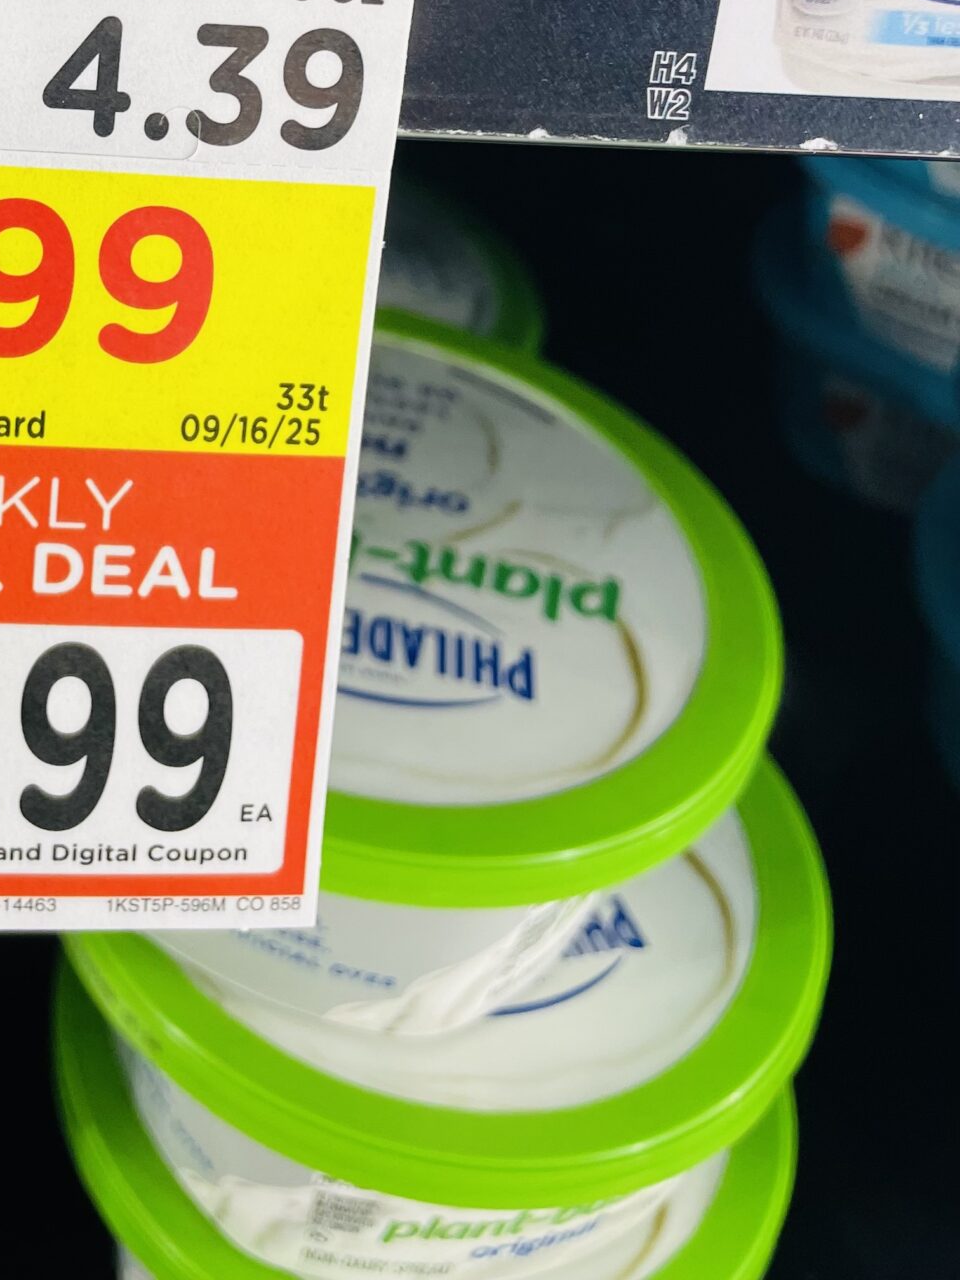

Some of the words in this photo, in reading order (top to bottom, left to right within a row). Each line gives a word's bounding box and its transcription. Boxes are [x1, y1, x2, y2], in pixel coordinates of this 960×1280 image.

[42, 15, 365, 151] 4.39
[649, 51, 697, 85] H4
[647, 87, 691, 121] W2
[276, 382, 330, 412] 33t
[180, 413, 321, 449] 09/16/25
[32, 542, 239, 600] DEAL
[240, 803, 273, 823] EA
[52, 843, 137, 866] Digital
[148, 843, 248, 866] Coupon
[236, 897, 264, 911] CO
[270, 896, 302, 911] 858
